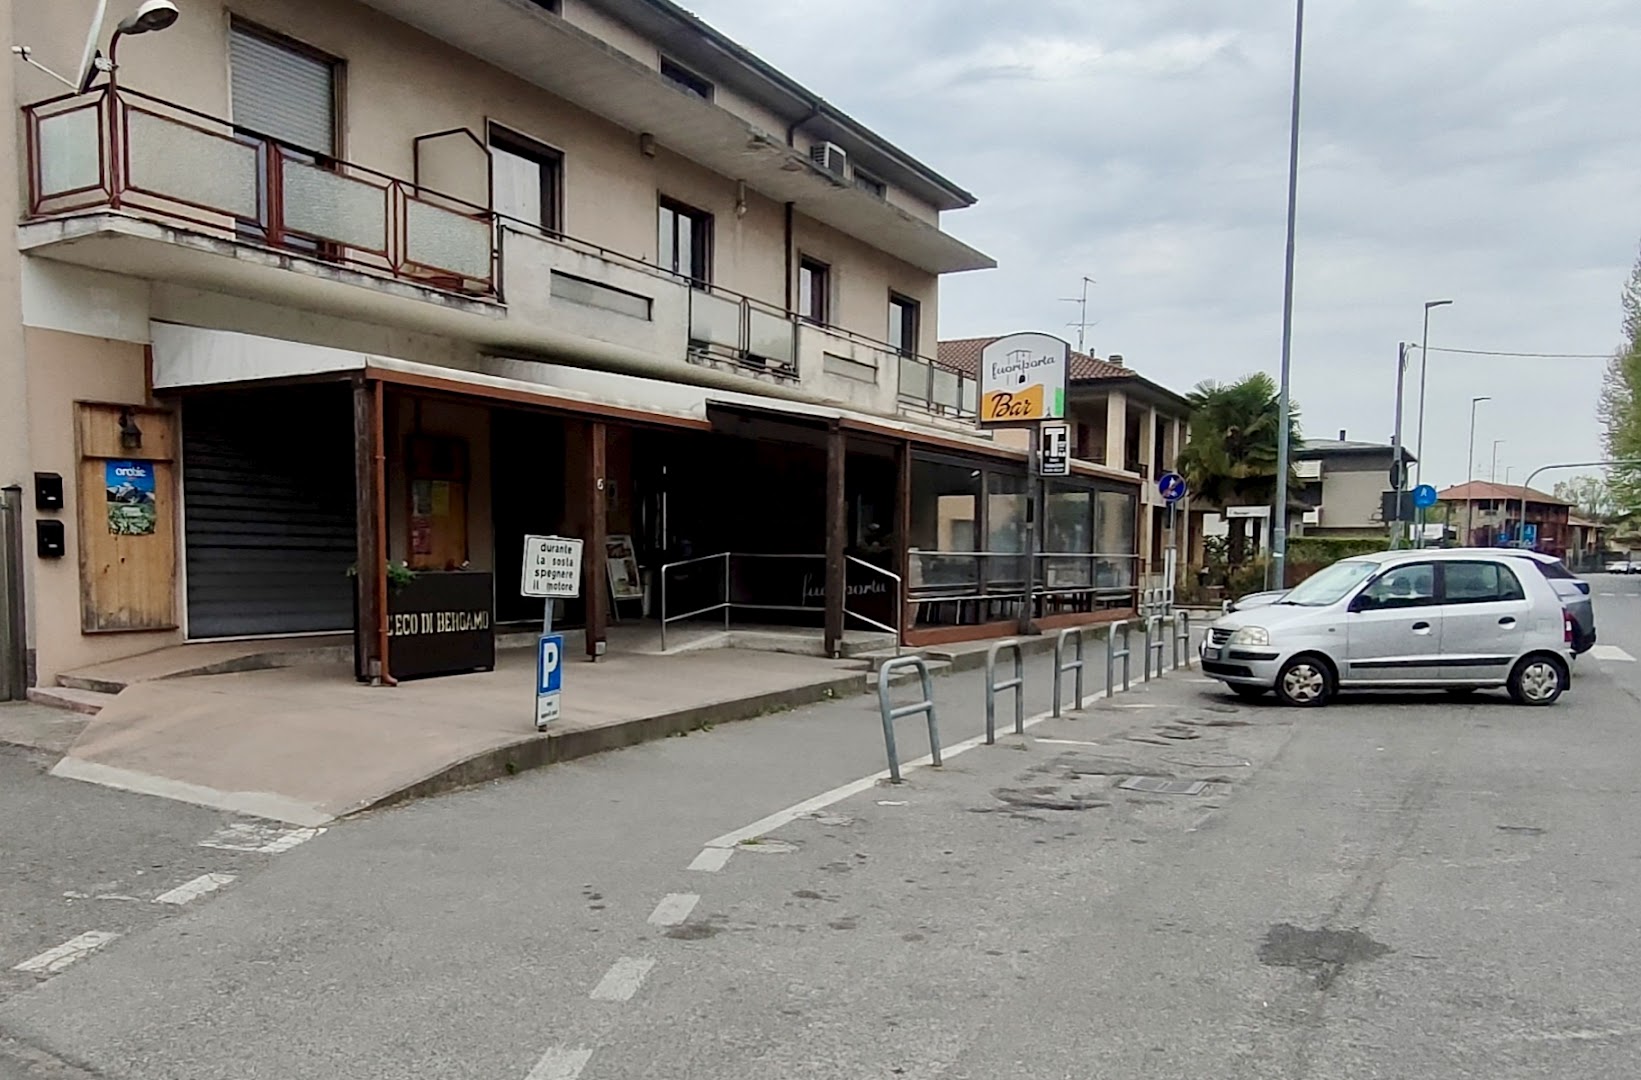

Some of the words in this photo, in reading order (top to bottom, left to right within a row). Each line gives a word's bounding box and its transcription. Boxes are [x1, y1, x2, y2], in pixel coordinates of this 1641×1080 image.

[992, 355, 1056, 380] fuoriporta
[991, 392, 1032, 418] Bar
[1045, 428, 1065, 457] T
[540, 543, 573, 554] durante
[536, 554, 546, 565] la
[552, 557, 573, 567] sosta
[534, 569, 573, 580] spegnere
[546, 582, 573, 592] motore
[421, 612, 434, 634] DI
[436, 611, 489, 633] BERGAMO
[542, 642, 559, 689] P
